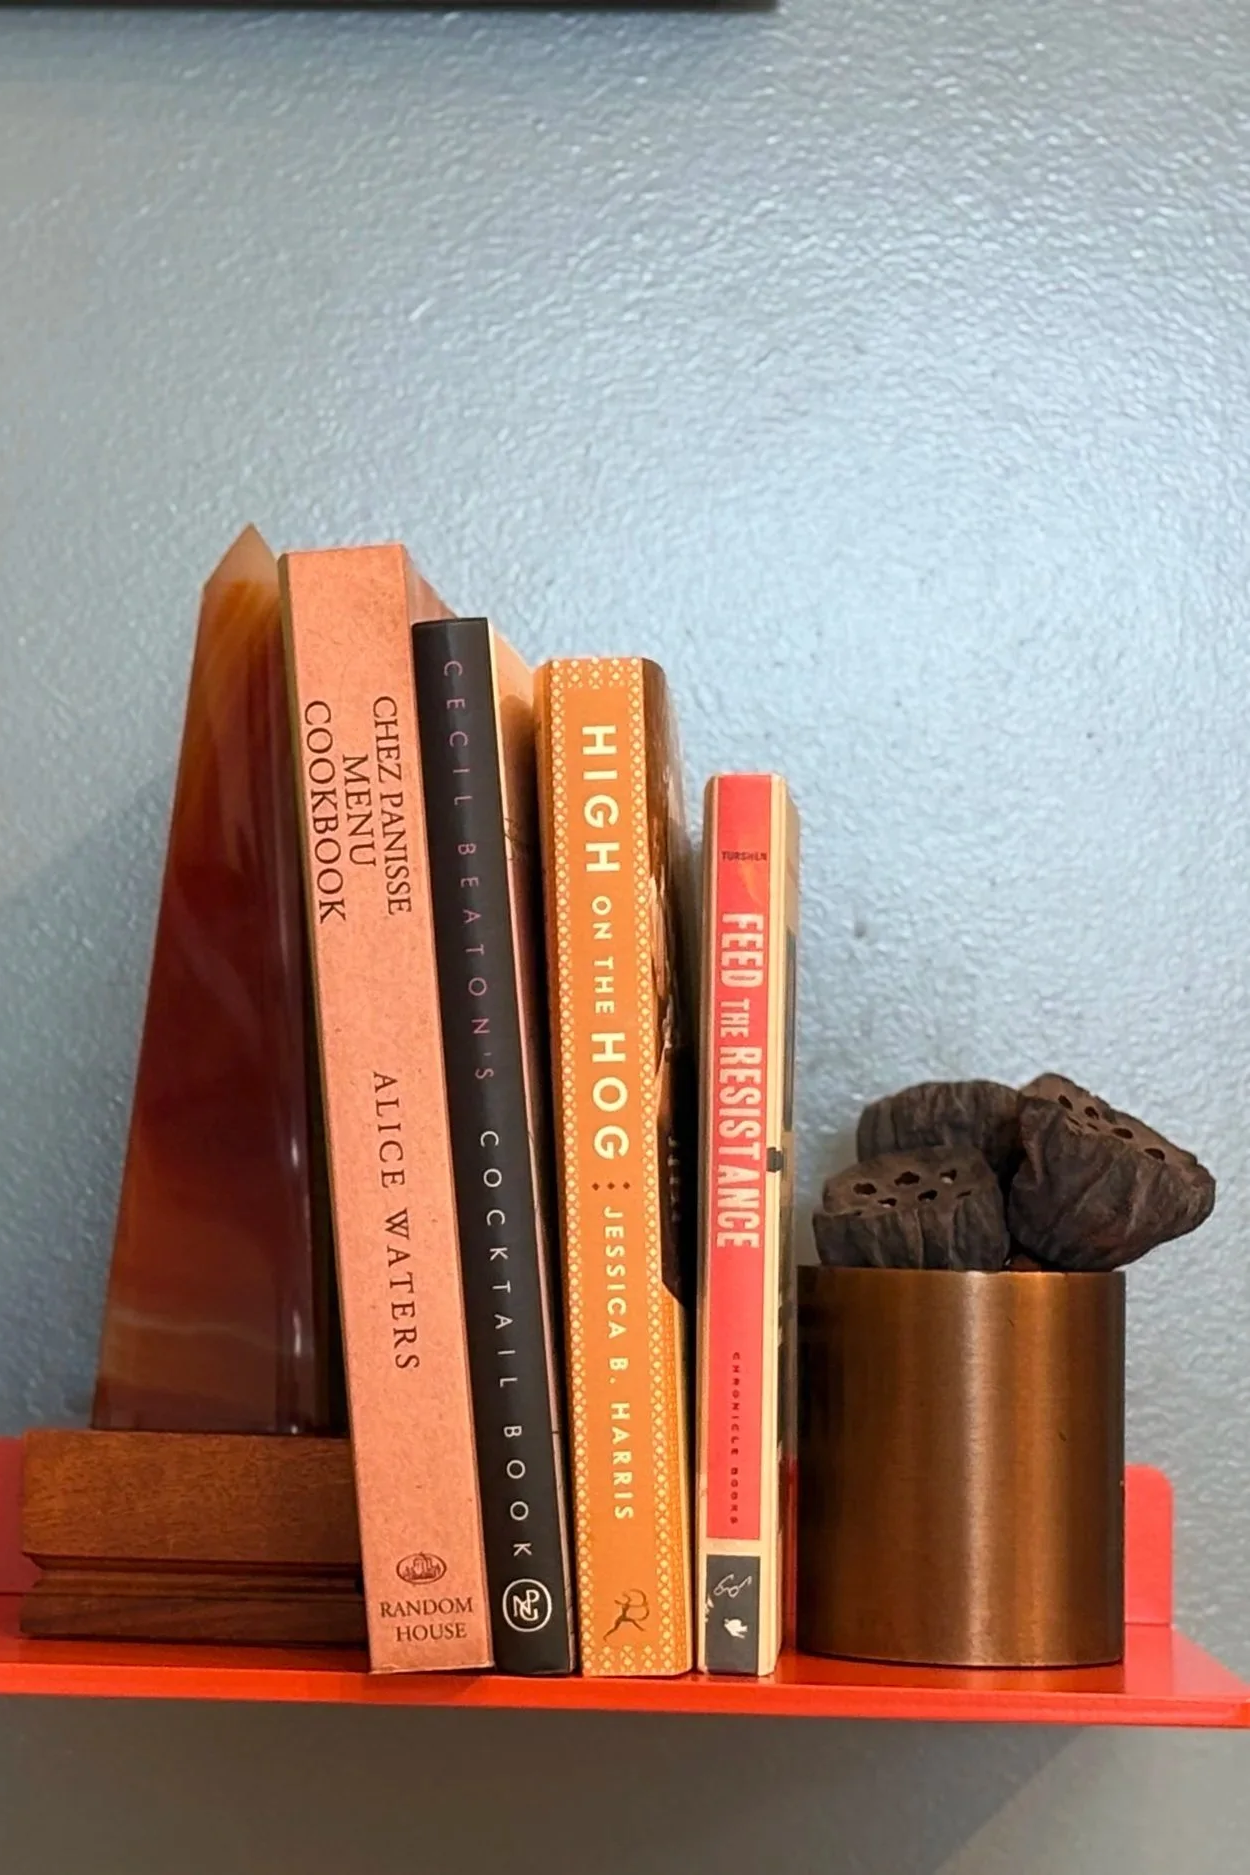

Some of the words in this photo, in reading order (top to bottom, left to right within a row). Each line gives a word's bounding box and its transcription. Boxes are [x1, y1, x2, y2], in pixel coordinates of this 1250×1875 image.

[372, 695, 401, 783] CHEZ
[303, 701, 347, 925] COOKBOOK
[342, 753, 377, 868] MENU
[380, 789, 413, 916] PANISSE
[582, 725, 620, 872] HIGH
[592, 895, 612, 940] ON
[720, 913, 765, 988] FEED
[594, 956, 614, 1014] THE
[720, 999, 750, 1038] THE
[374, 1071, 405, 1188] ALICE
[444, 660, 474, 806] CECIL
[480, 1131, 518, 1388] COCKTAIL
[503, 1425, 532, 1556] BOOK
[592, 1032, 630, 1161] HOG
[716, 1047, 763, 1248] RESISTANCE
[384, 1208, 420, 1369] WATERS
[604, 1207, 628, 1338] JESSICA
[609, 1356, 627, 1385] B.
[609, 1403, 634, 1520] HARRIS
[380, 1597, 474, 1618] RANDOM
[396, 1623, 468, 1642] HOUSE
